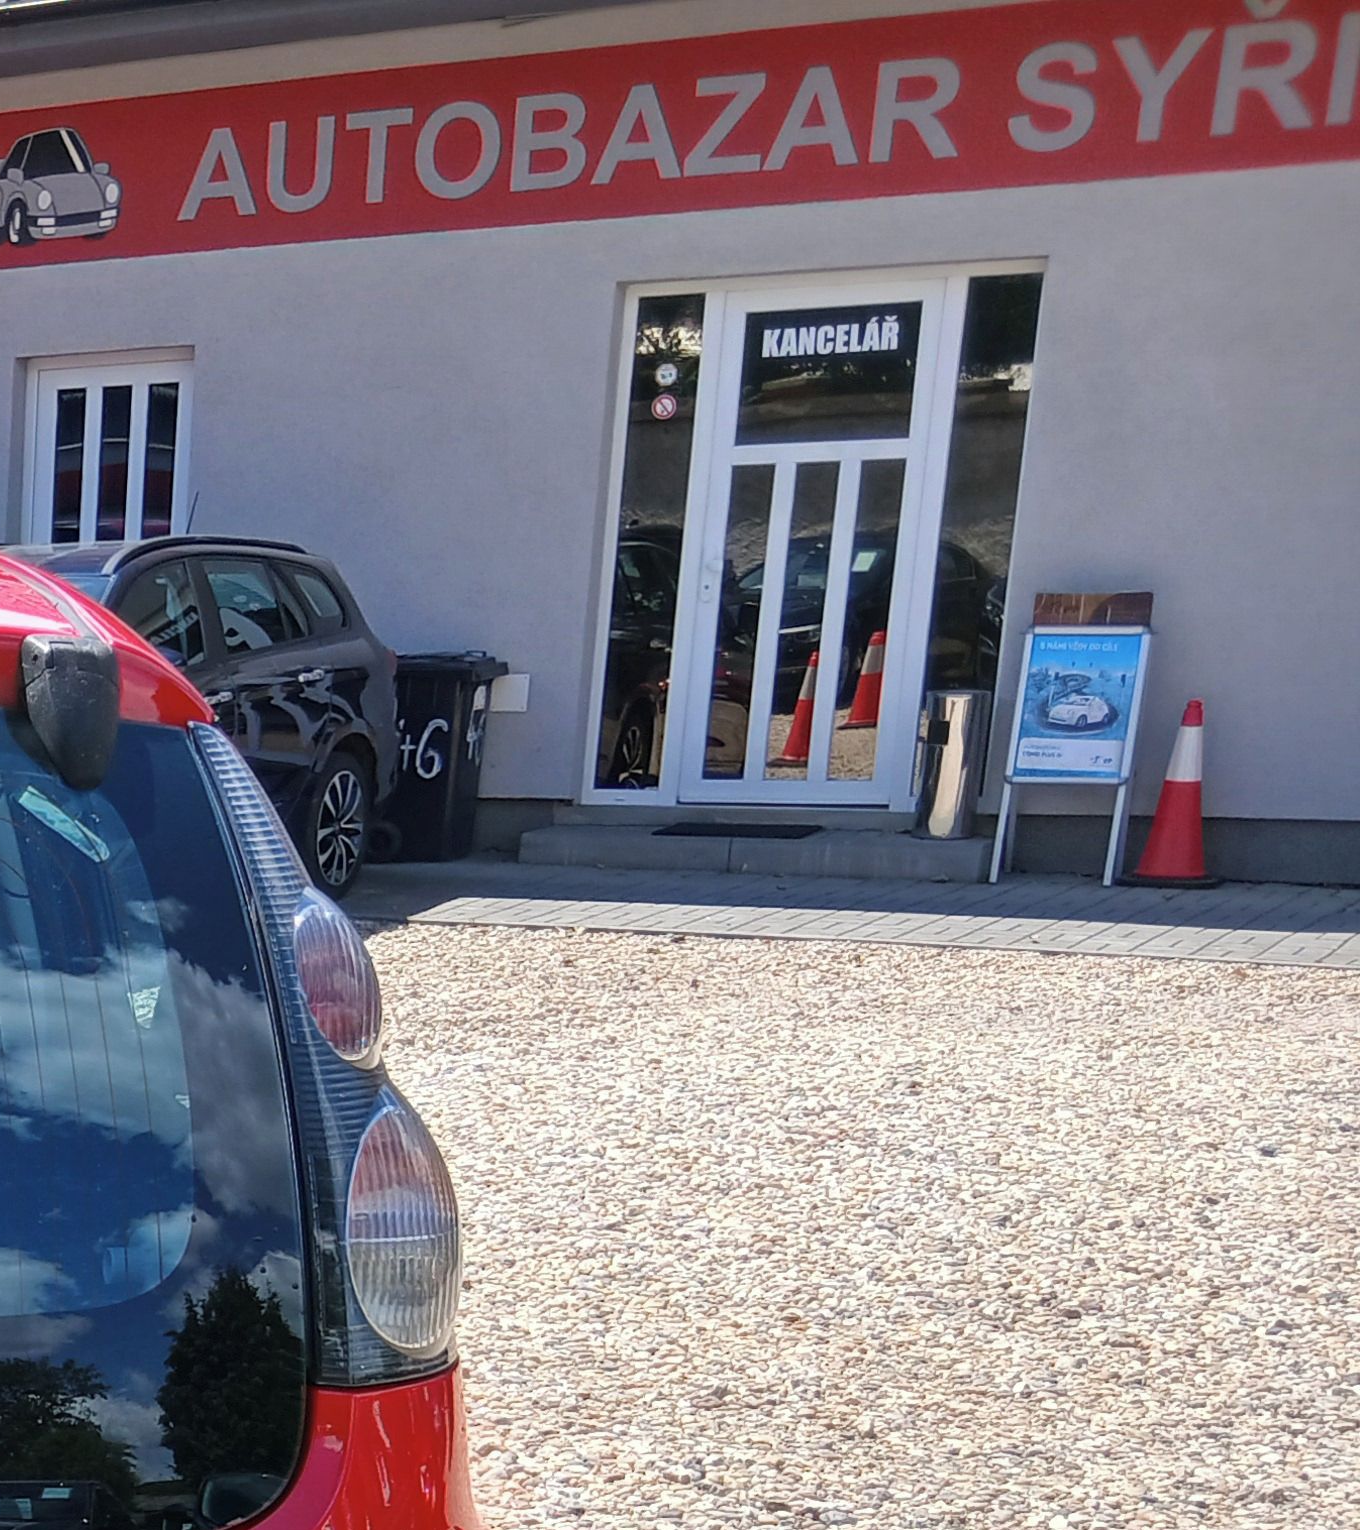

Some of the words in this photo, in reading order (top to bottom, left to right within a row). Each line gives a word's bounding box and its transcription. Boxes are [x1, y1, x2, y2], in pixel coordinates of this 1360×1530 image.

[177, 56, 962, 221] AUTOBAZAR
[1008, 0, 1360, 153] SYŘI
[761, 315, 900, 358] KANCELÁŘ
